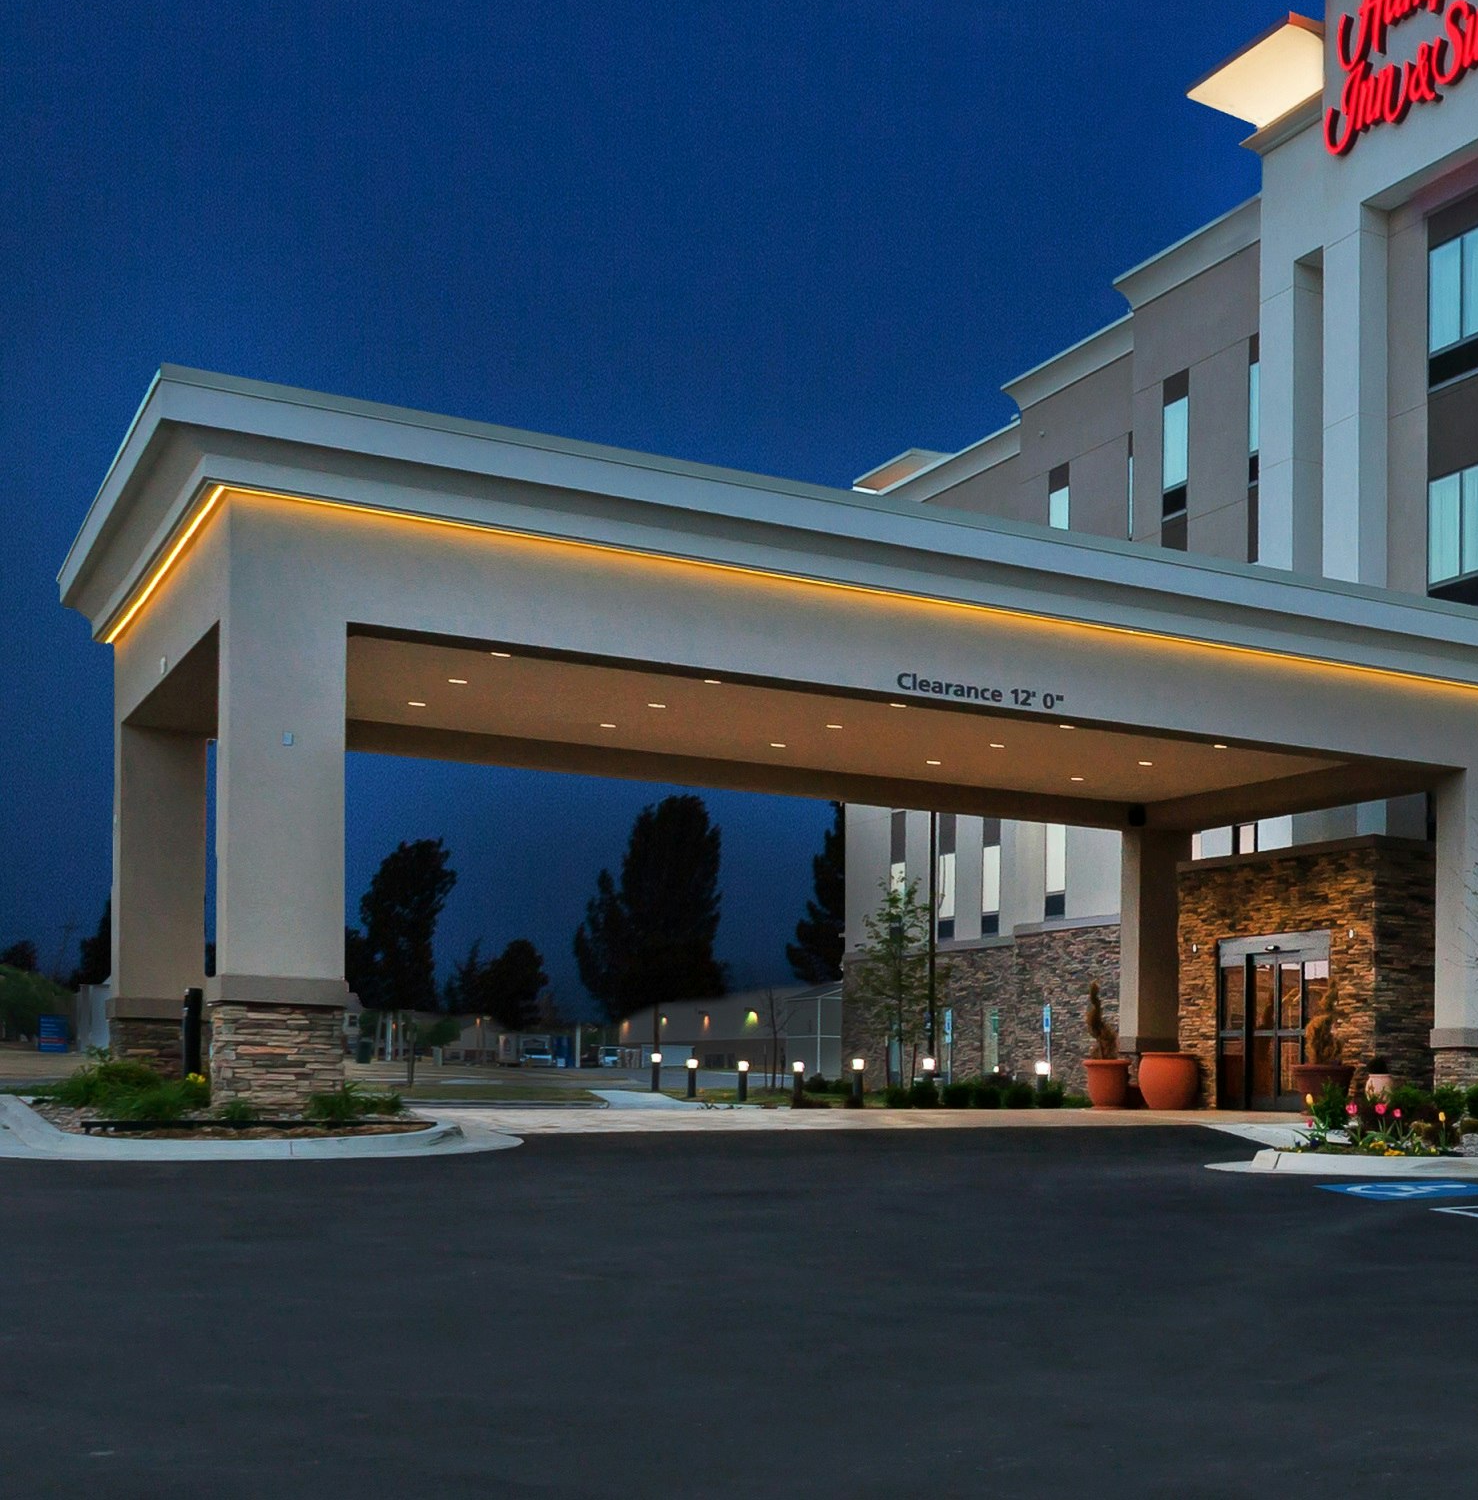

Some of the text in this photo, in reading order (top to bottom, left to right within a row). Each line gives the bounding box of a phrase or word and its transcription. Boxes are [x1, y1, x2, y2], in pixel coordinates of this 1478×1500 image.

[1324, 60, 1414, 155] Inn
[1410, 42, 1443, 102] &
[897, 672, 1003, 703] Clearance
